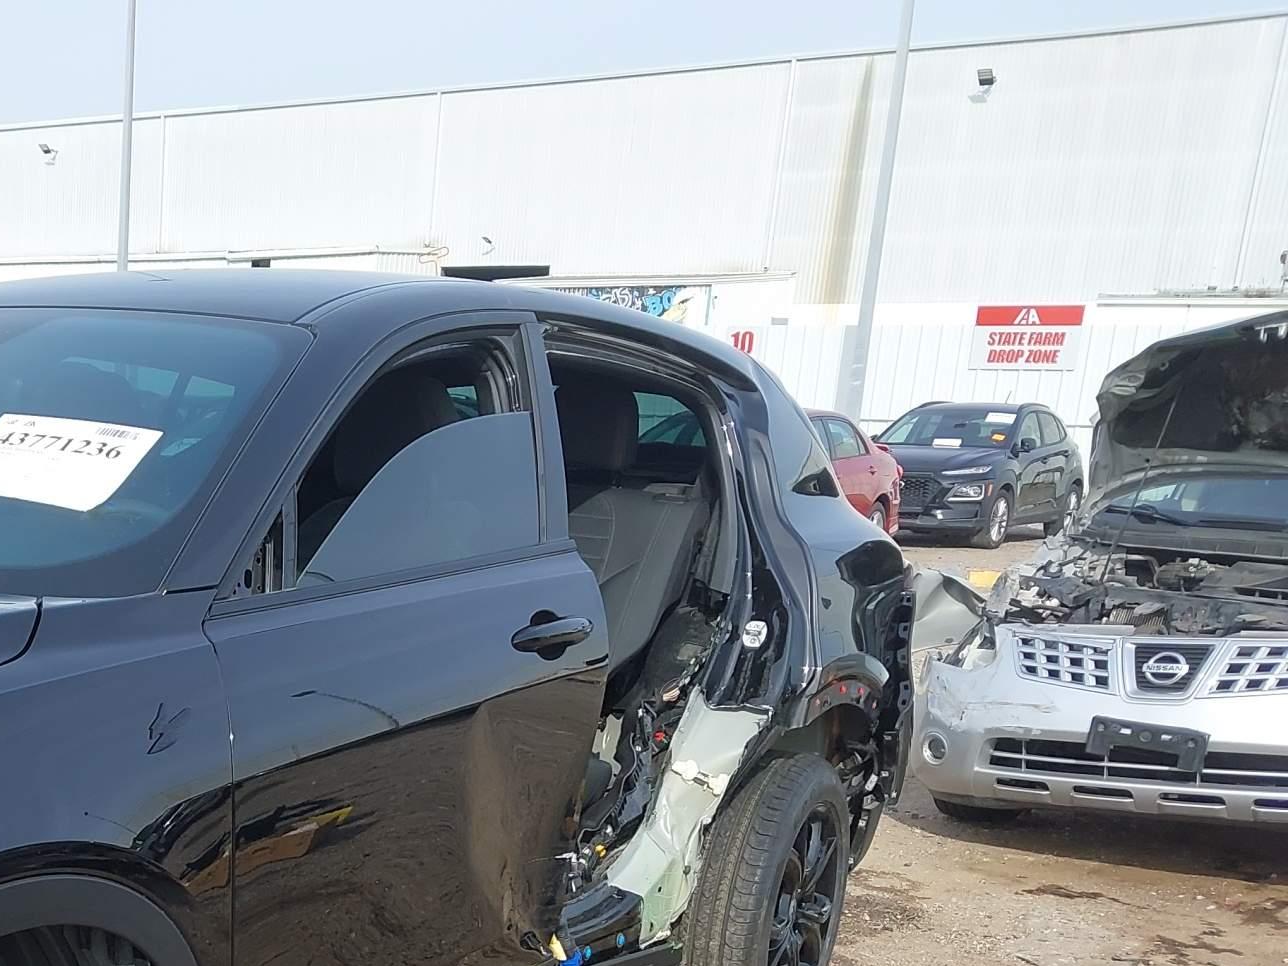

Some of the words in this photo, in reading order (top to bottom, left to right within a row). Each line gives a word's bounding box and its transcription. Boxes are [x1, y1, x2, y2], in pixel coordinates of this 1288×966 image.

[731, 331, 754, 353] 10
[987, 331, 1027, 346] STATE
[1028, 331, 1066, 346] FARM
[987, 349, 1024, 363] DROP
[1024, 349, 1060, 364] ZONE
